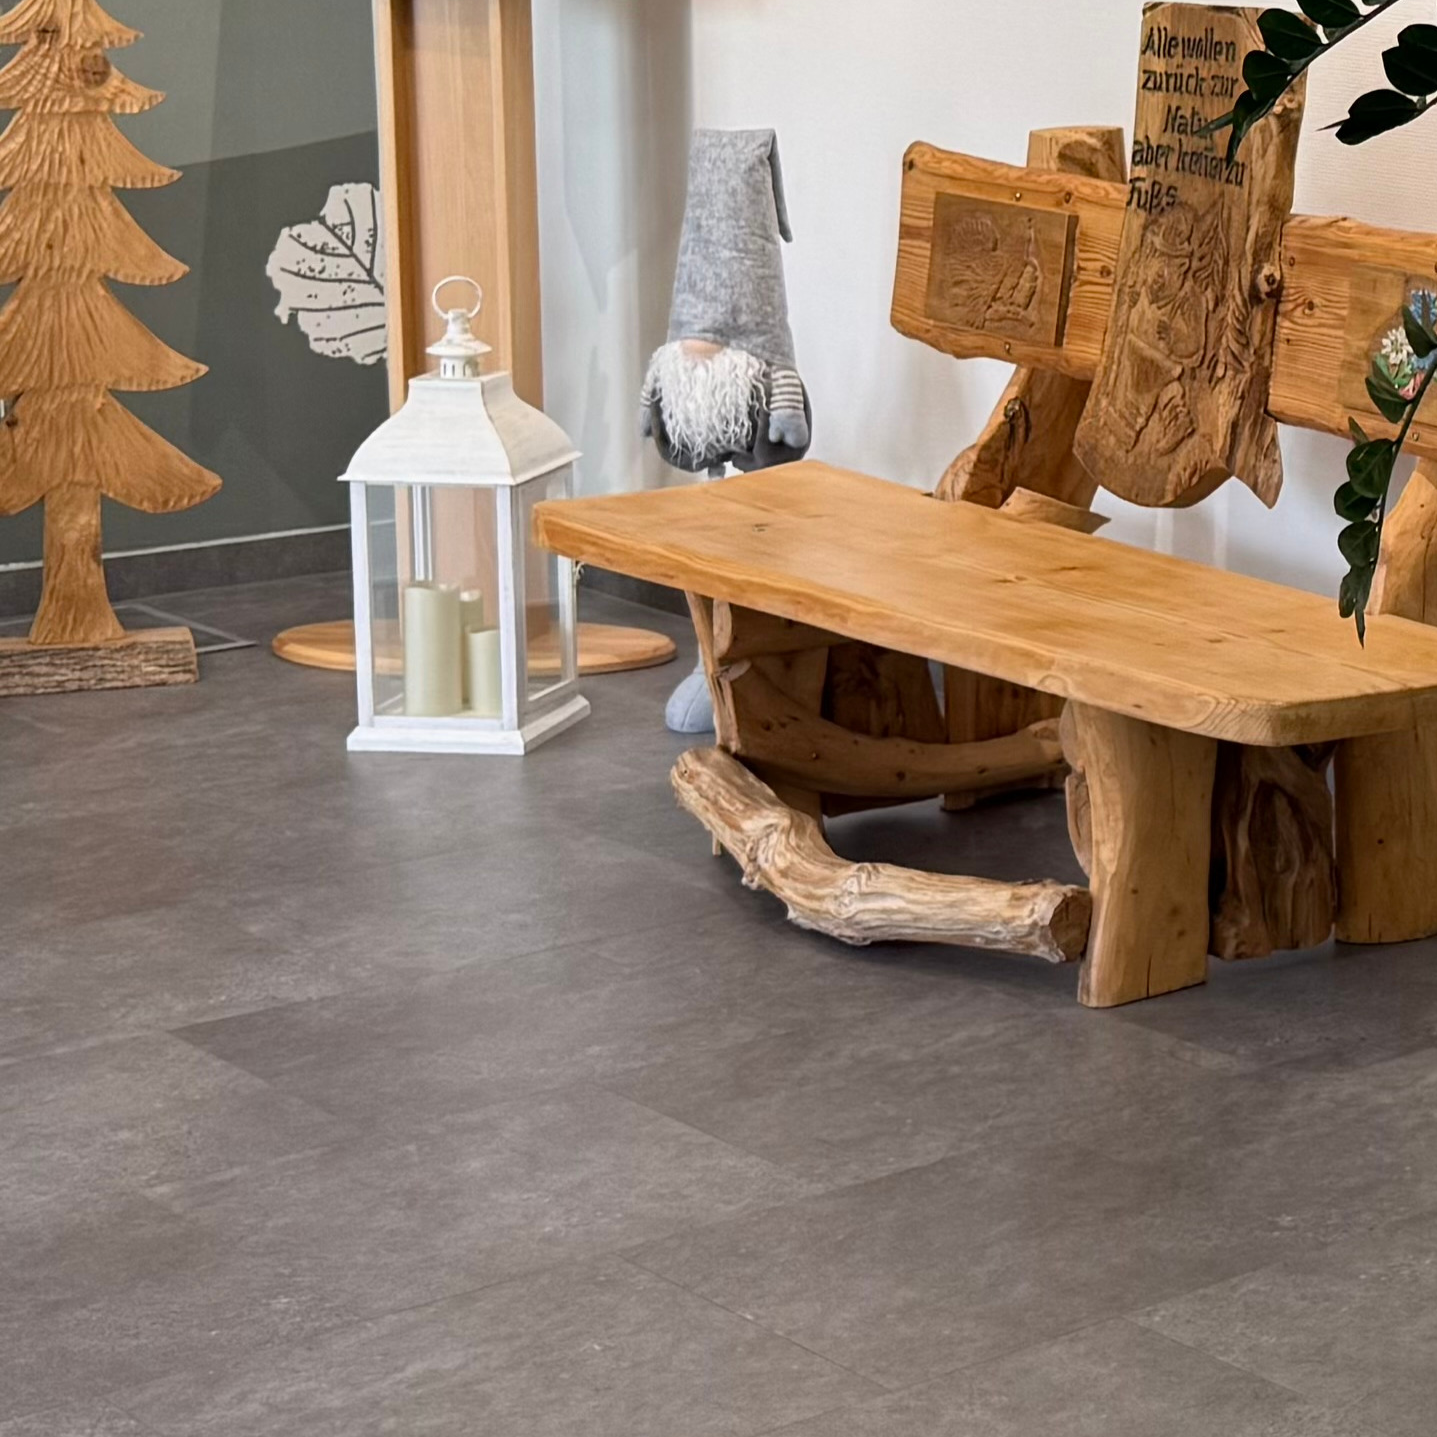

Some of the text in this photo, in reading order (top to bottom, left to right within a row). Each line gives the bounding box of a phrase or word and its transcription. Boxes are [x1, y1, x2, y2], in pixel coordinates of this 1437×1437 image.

[1141, 26, 1237, 62] Alle wollen
[1142, 64, 1239, 99] zurück zur
[1163, 104, 1214, 141] Nat
[1131, 135, 1174, 172] aber
